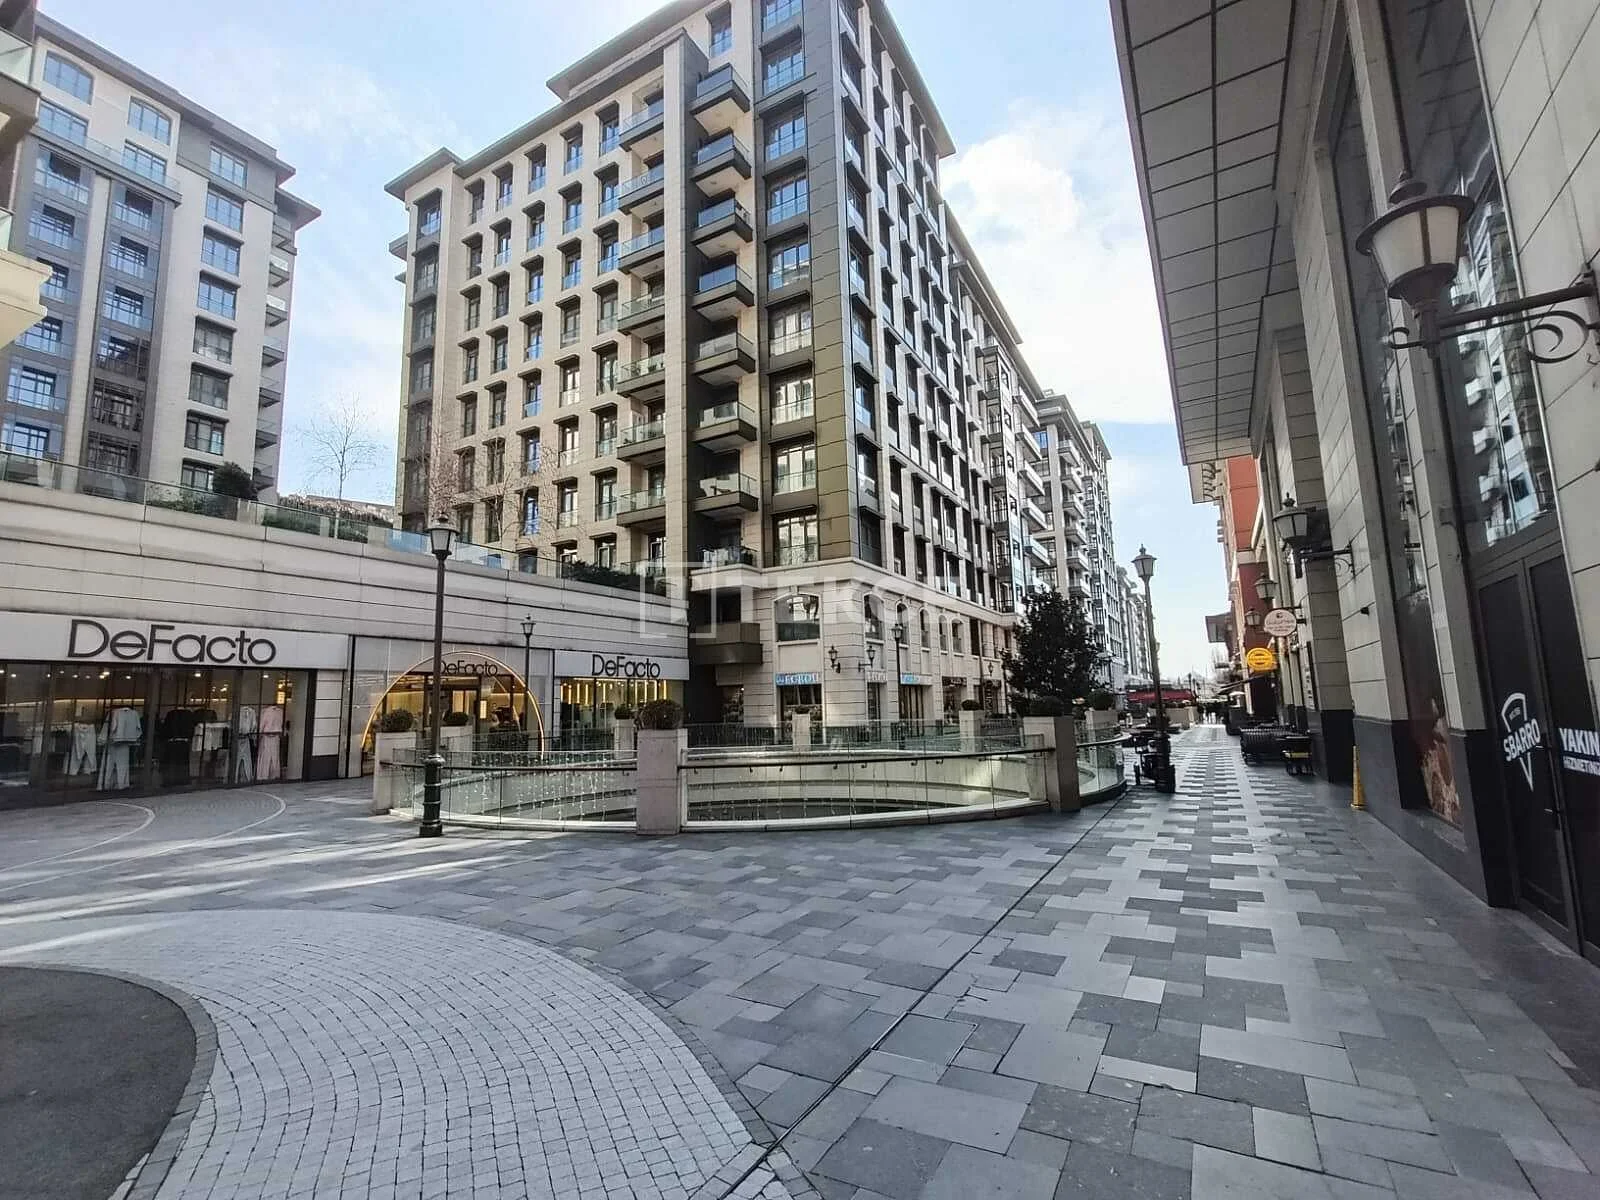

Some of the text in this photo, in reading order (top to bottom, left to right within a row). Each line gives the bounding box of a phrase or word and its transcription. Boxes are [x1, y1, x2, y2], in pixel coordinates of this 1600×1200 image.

[67, 618, 276, 665] DeFacto
[591, 654, 661, 678] DeFacto
[1503, 718, 1541, 762] SBARRO
